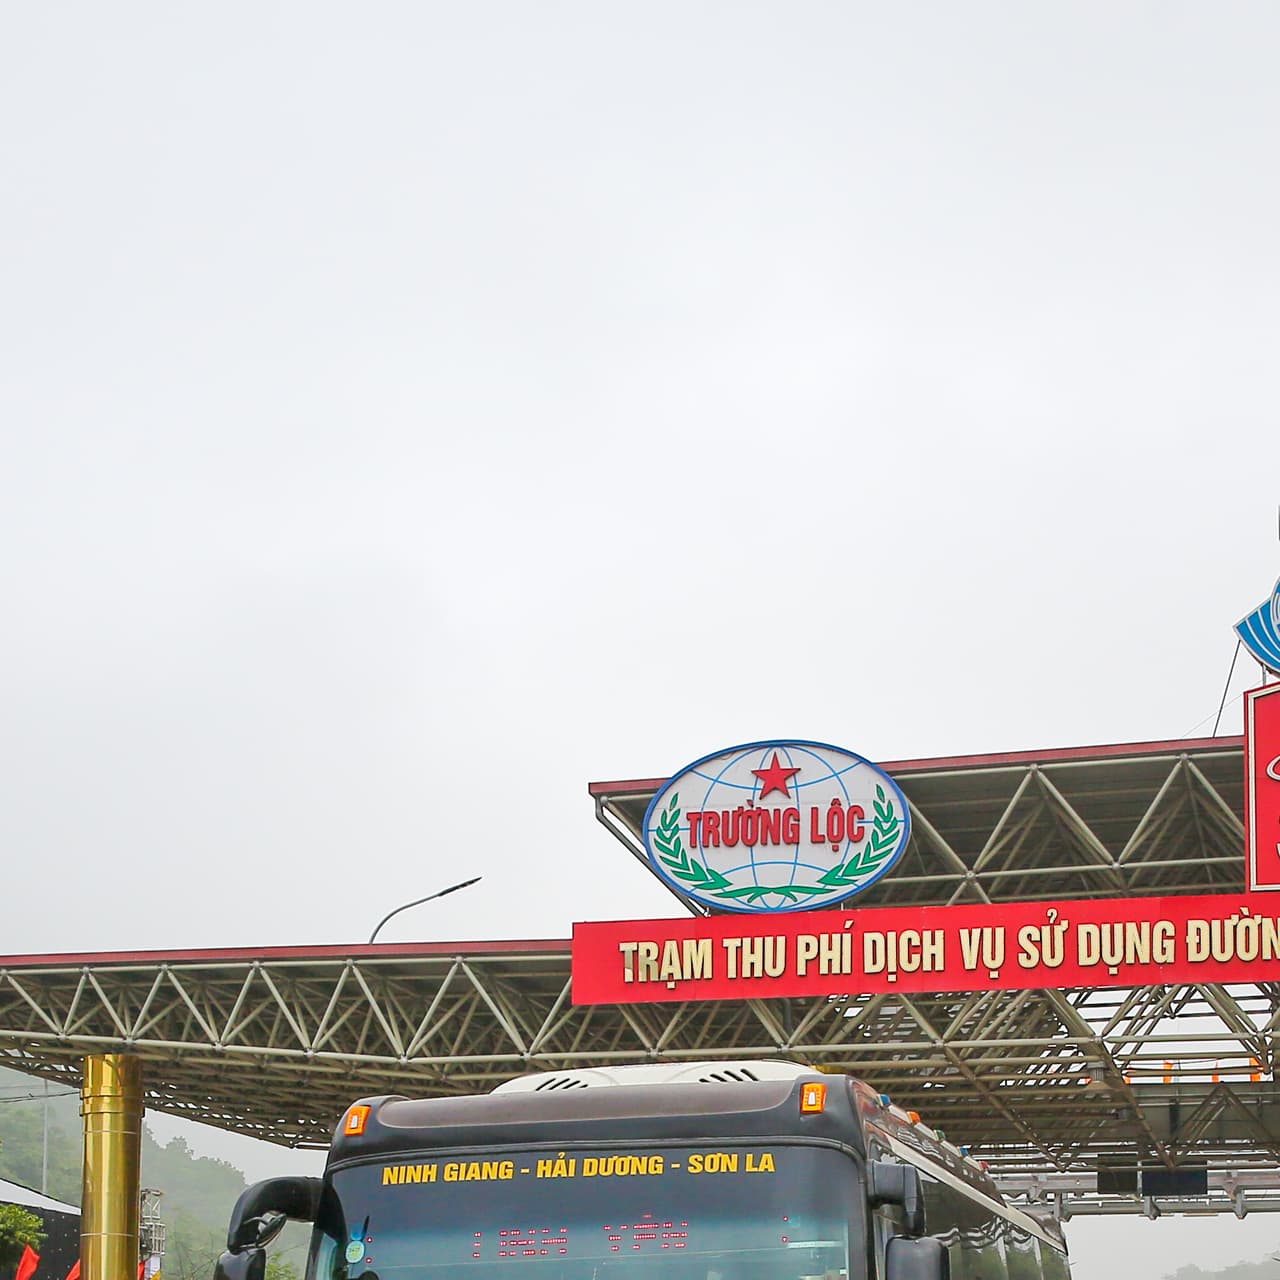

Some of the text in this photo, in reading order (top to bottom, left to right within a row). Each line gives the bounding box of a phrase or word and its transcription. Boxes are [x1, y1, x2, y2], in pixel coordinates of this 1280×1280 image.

[686, 798, 866, 852] TRƯỜNG LỘC
[619, 937, 713, 990] TRẠM
[722, 935, 787, 980] THU
[796, 919, 855, 977] PHÍ
[863, 928, 945, 983] DỊCH
[959, 926, 1006, 979] VỤ
[1017, 907, 1069, 969] SỬ
[1077, 920, 1176, 976] DỤNG
[381, 1152, 775, 1186] NINH GIANG HẢI DƯƠNG SƠN LA
